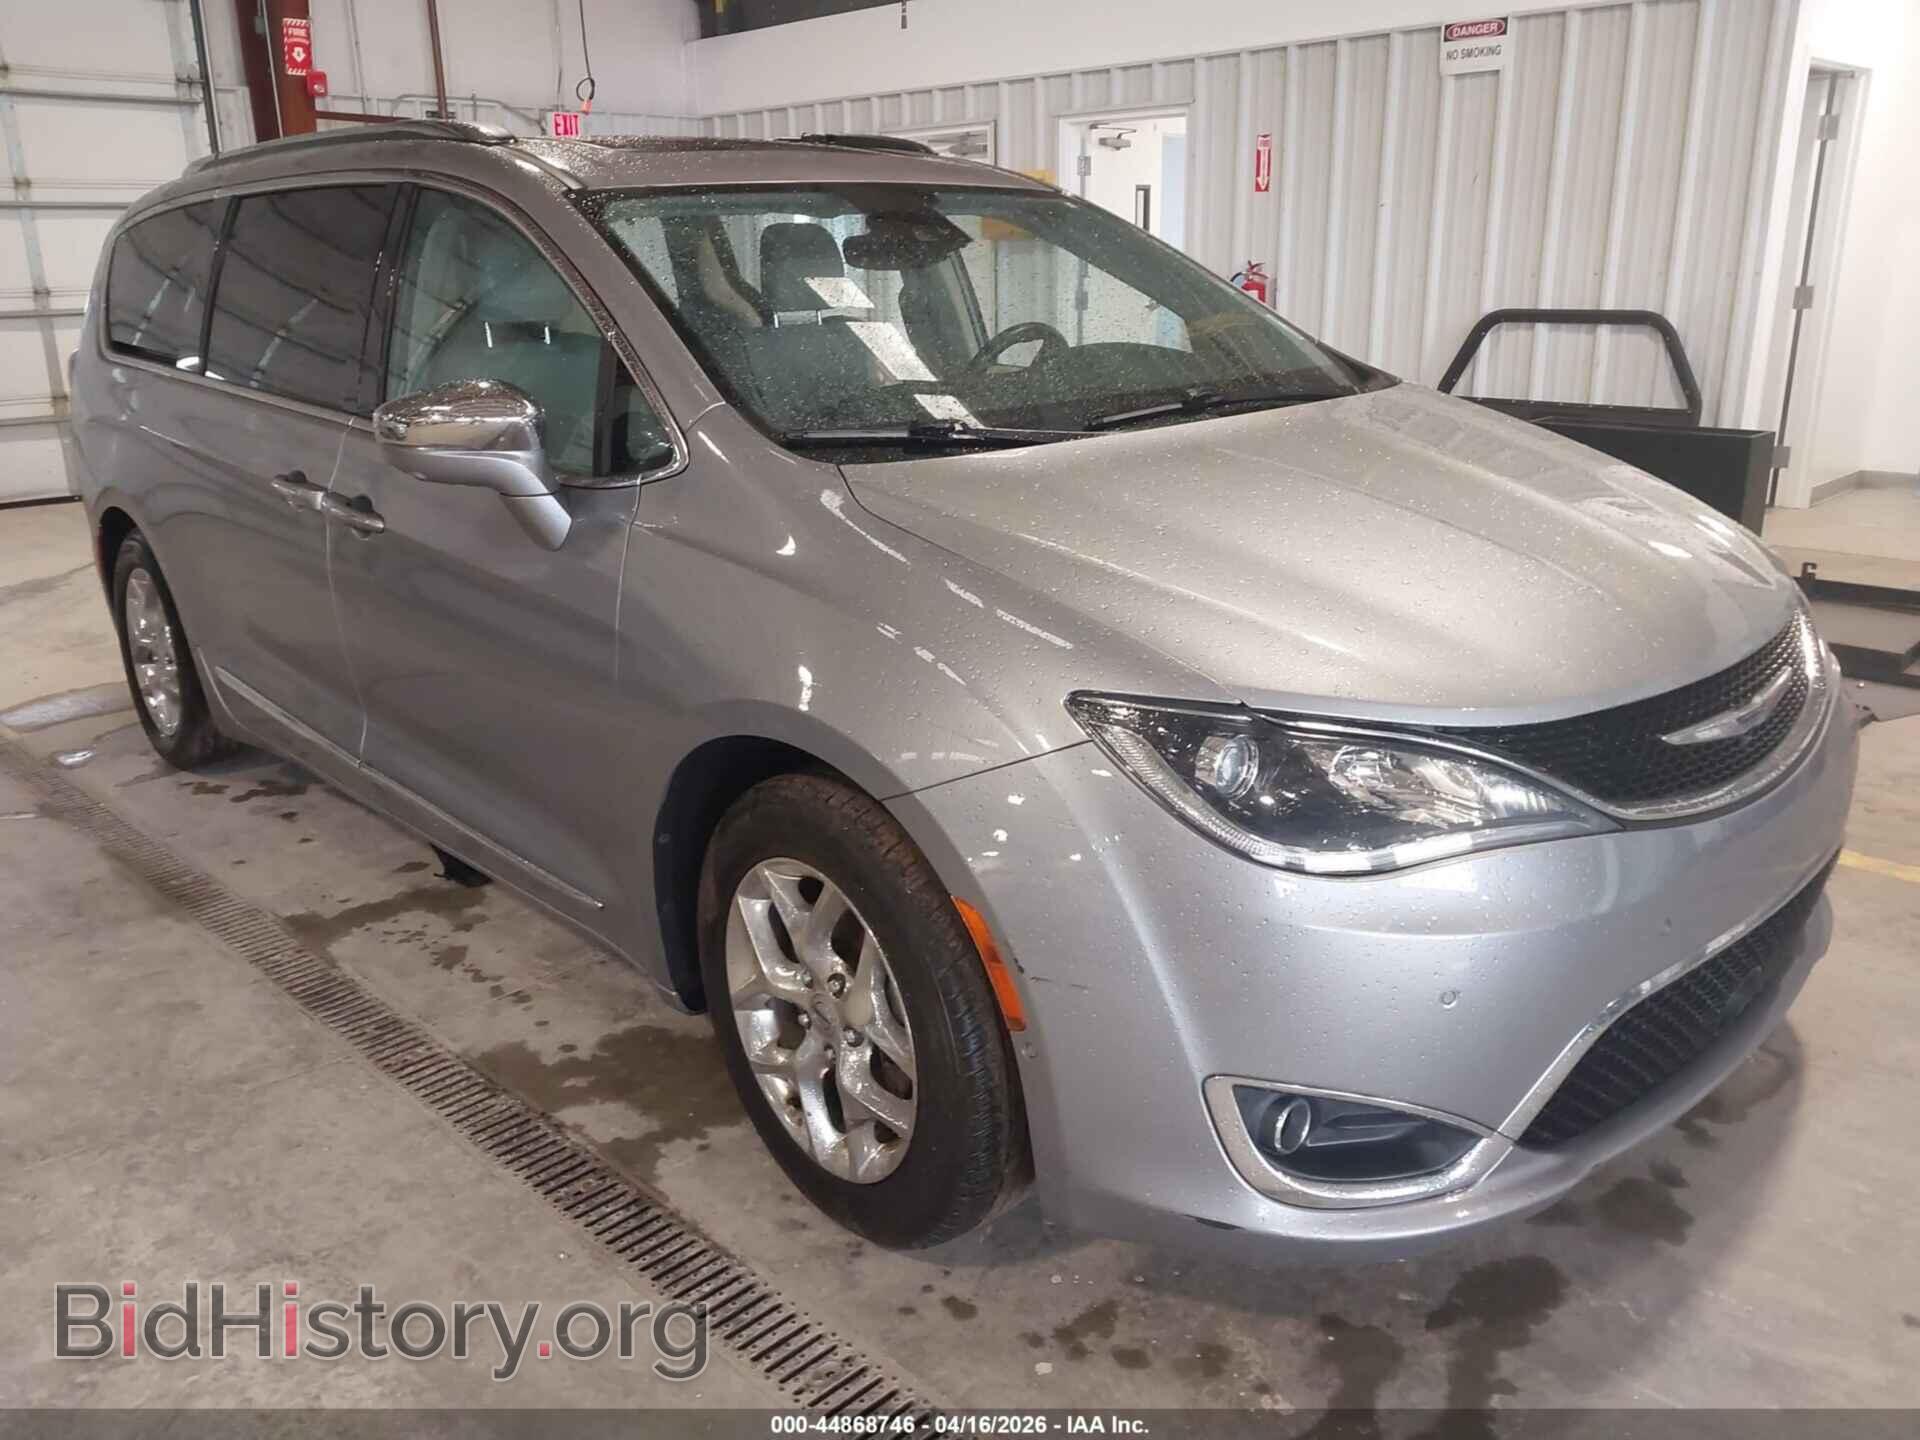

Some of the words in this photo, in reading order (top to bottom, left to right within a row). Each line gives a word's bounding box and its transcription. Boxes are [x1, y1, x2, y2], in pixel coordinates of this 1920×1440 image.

[1452, 22, 1498, 37] DANGER
[1446, 49, 1459, 60] NO
[1461, 44, 1502, 59] SMOKING
[554, 113, 579, 137] EXIT
